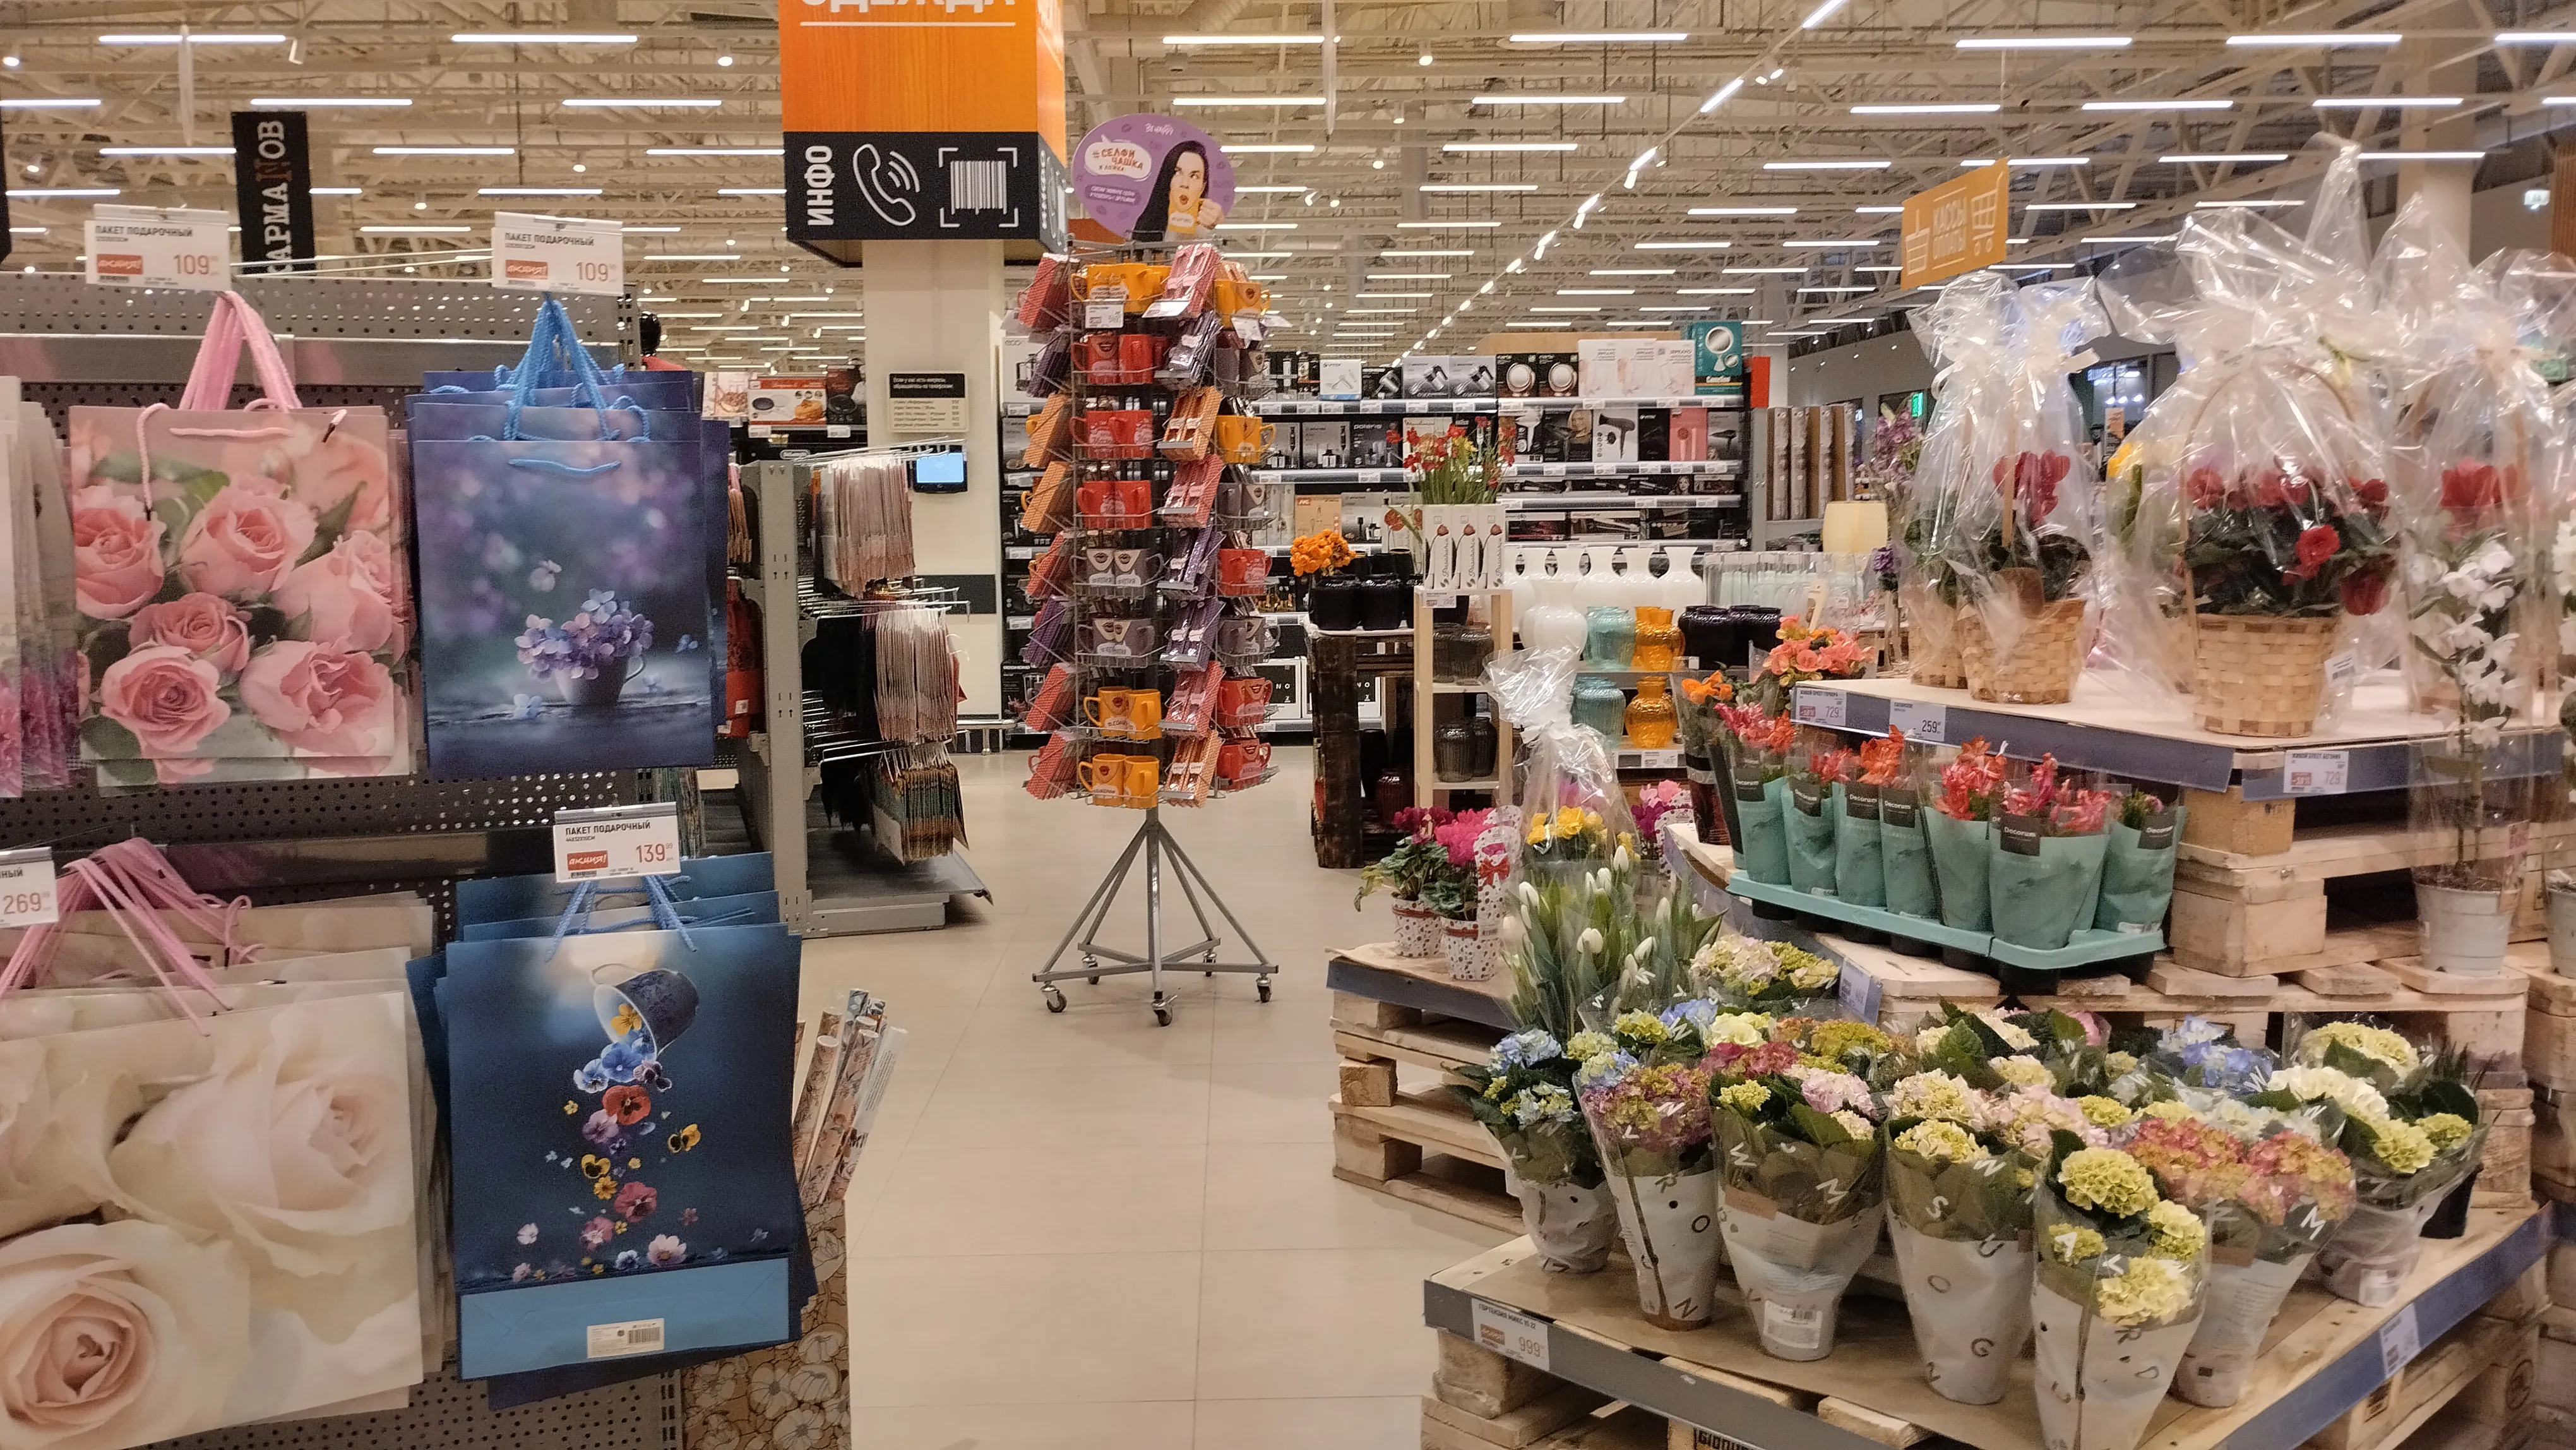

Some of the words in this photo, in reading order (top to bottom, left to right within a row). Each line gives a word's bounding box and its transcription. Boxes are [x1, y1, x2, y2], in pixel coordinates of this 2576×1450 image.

[1112, 157, 1143, 170] ЧАШКА
[805, 145, 834, 226] ИНФО
[95, 225, 123, 234] ПАКЕТ
[127, 227, 193, 237] ПОДАРОЧНЫЙ
[505, 232, 532, 242] ПАКЕТ
[534, 234, 595, 246] ПОДАРОЧНЫЙ
[174, 254, 210, 275] 109
[576, 261, 608, 282] 109
[1826, 706, 1839, 718] 729
[1922, 719, 1937, 734] 259
[1849, 794, 1877, 803] Decorum
[1884, 800, 1911, 810] Decorum
[566, 826, 591, 836] ПАКЕТ
[593, 820, 651, 834] ПОДАРОЧНЫЙ
[2004, 826, 2036, 838] Decorum
[568, 854, 607, 866] акция!
[636, 843, 665, 863] 139
[0, 867, 23, 878] НЫЙ
[3, 892, 42, 914] 269
[1518, 1336, 1541, 1357] 999
